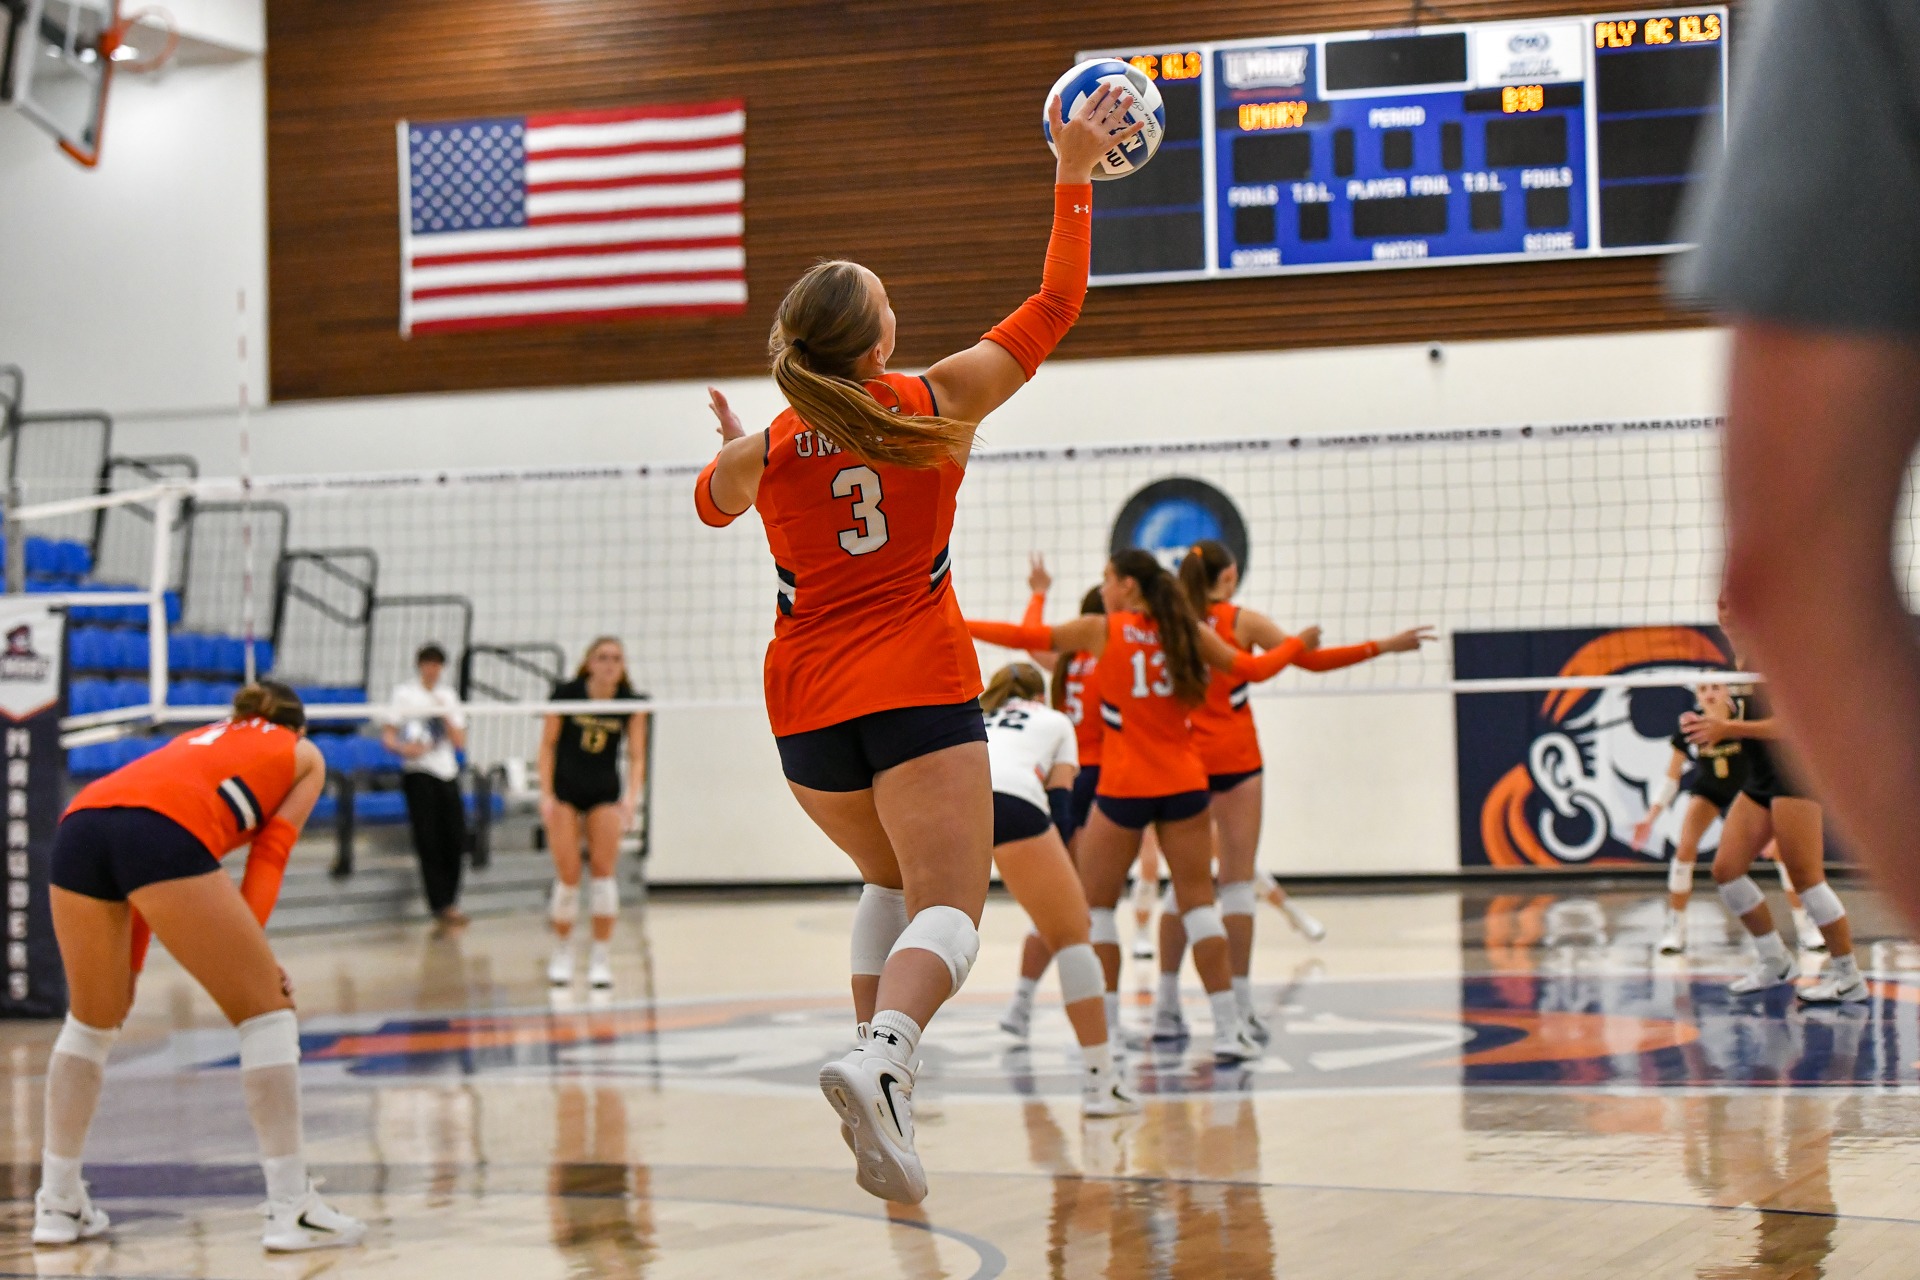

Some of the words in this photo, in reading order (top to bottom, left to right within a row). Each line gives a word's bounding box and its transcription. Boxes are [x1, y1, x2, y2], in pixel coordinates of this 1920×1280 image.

[1595, 20, 1637, 49] PLY
[1521, 167, 1573, 189] FOULS
[1623, 416, 1725, 431] MARAUDER
[831, 465, 889, 557] 3
[1131, 649, 1174, 698] 13
